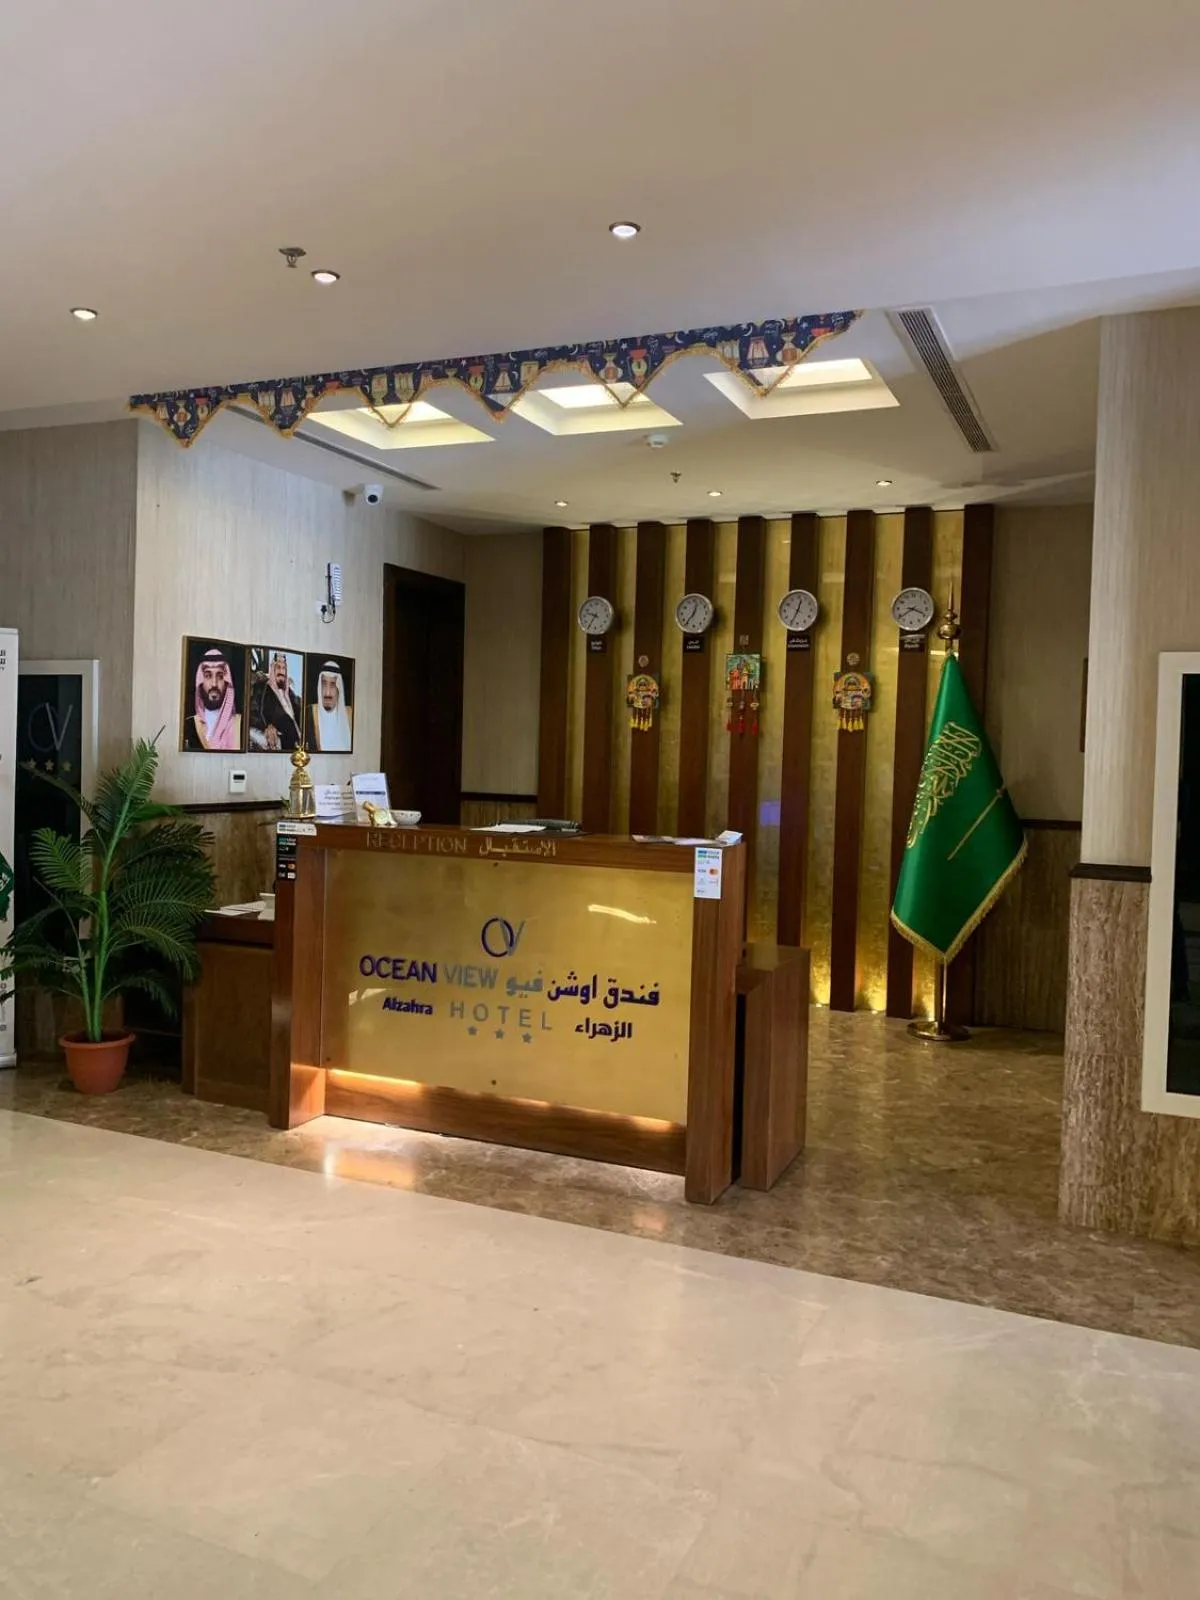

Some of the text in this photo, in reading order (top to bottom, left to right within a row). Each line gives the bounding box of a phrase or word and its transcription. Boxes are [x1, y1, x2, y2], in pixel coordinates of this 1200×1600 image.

[366, 830, 468, 853] RECEPTION
[359, 955, 499, 990] OCEAN VIEW
[506, 969, 660, 1009] فندق اوشن فيو
[382, 996, 433, 1015] Alzahra
[450, 1001, 553, 1031] HOTEL
[575, 1017, 633, 1042] الزهراء
